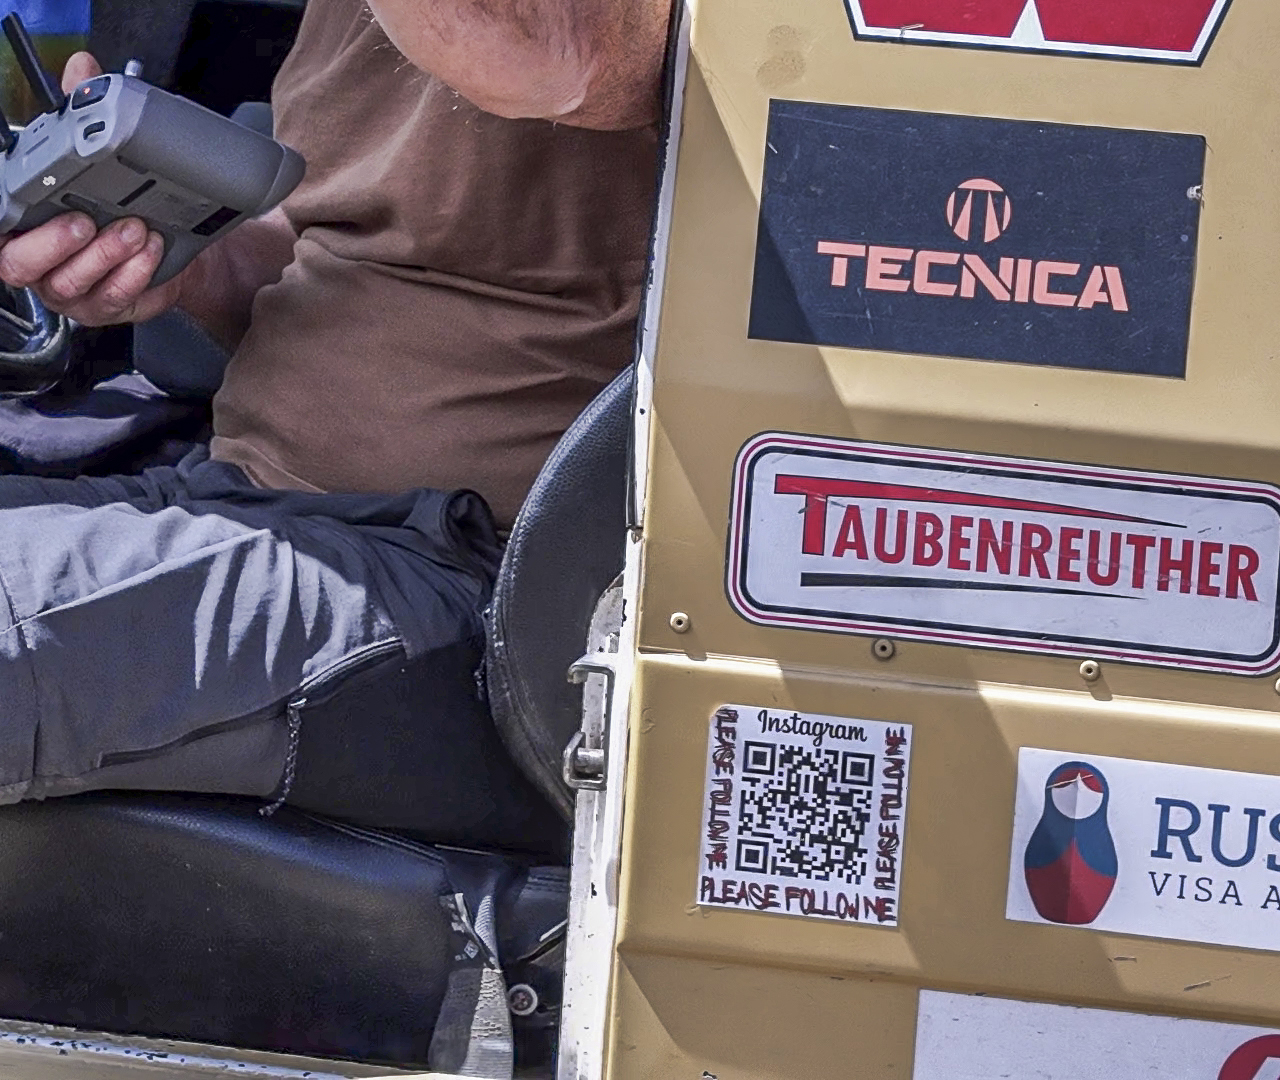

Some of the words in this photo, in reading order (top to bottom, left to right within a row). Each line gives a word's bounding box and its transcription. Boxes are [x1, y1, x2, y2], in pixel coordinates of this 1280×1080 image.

[816, 241, 1130, 312] TECNICA
[773, 472, 1260, 602] TAUBENREUTHER
[758, 709, 868, 747] Instagram
[700, 875, 781, 910] PLEASE
[785, 886, 859, 920] FOLLOW
[1148, 872, 1244, 909] VISA
